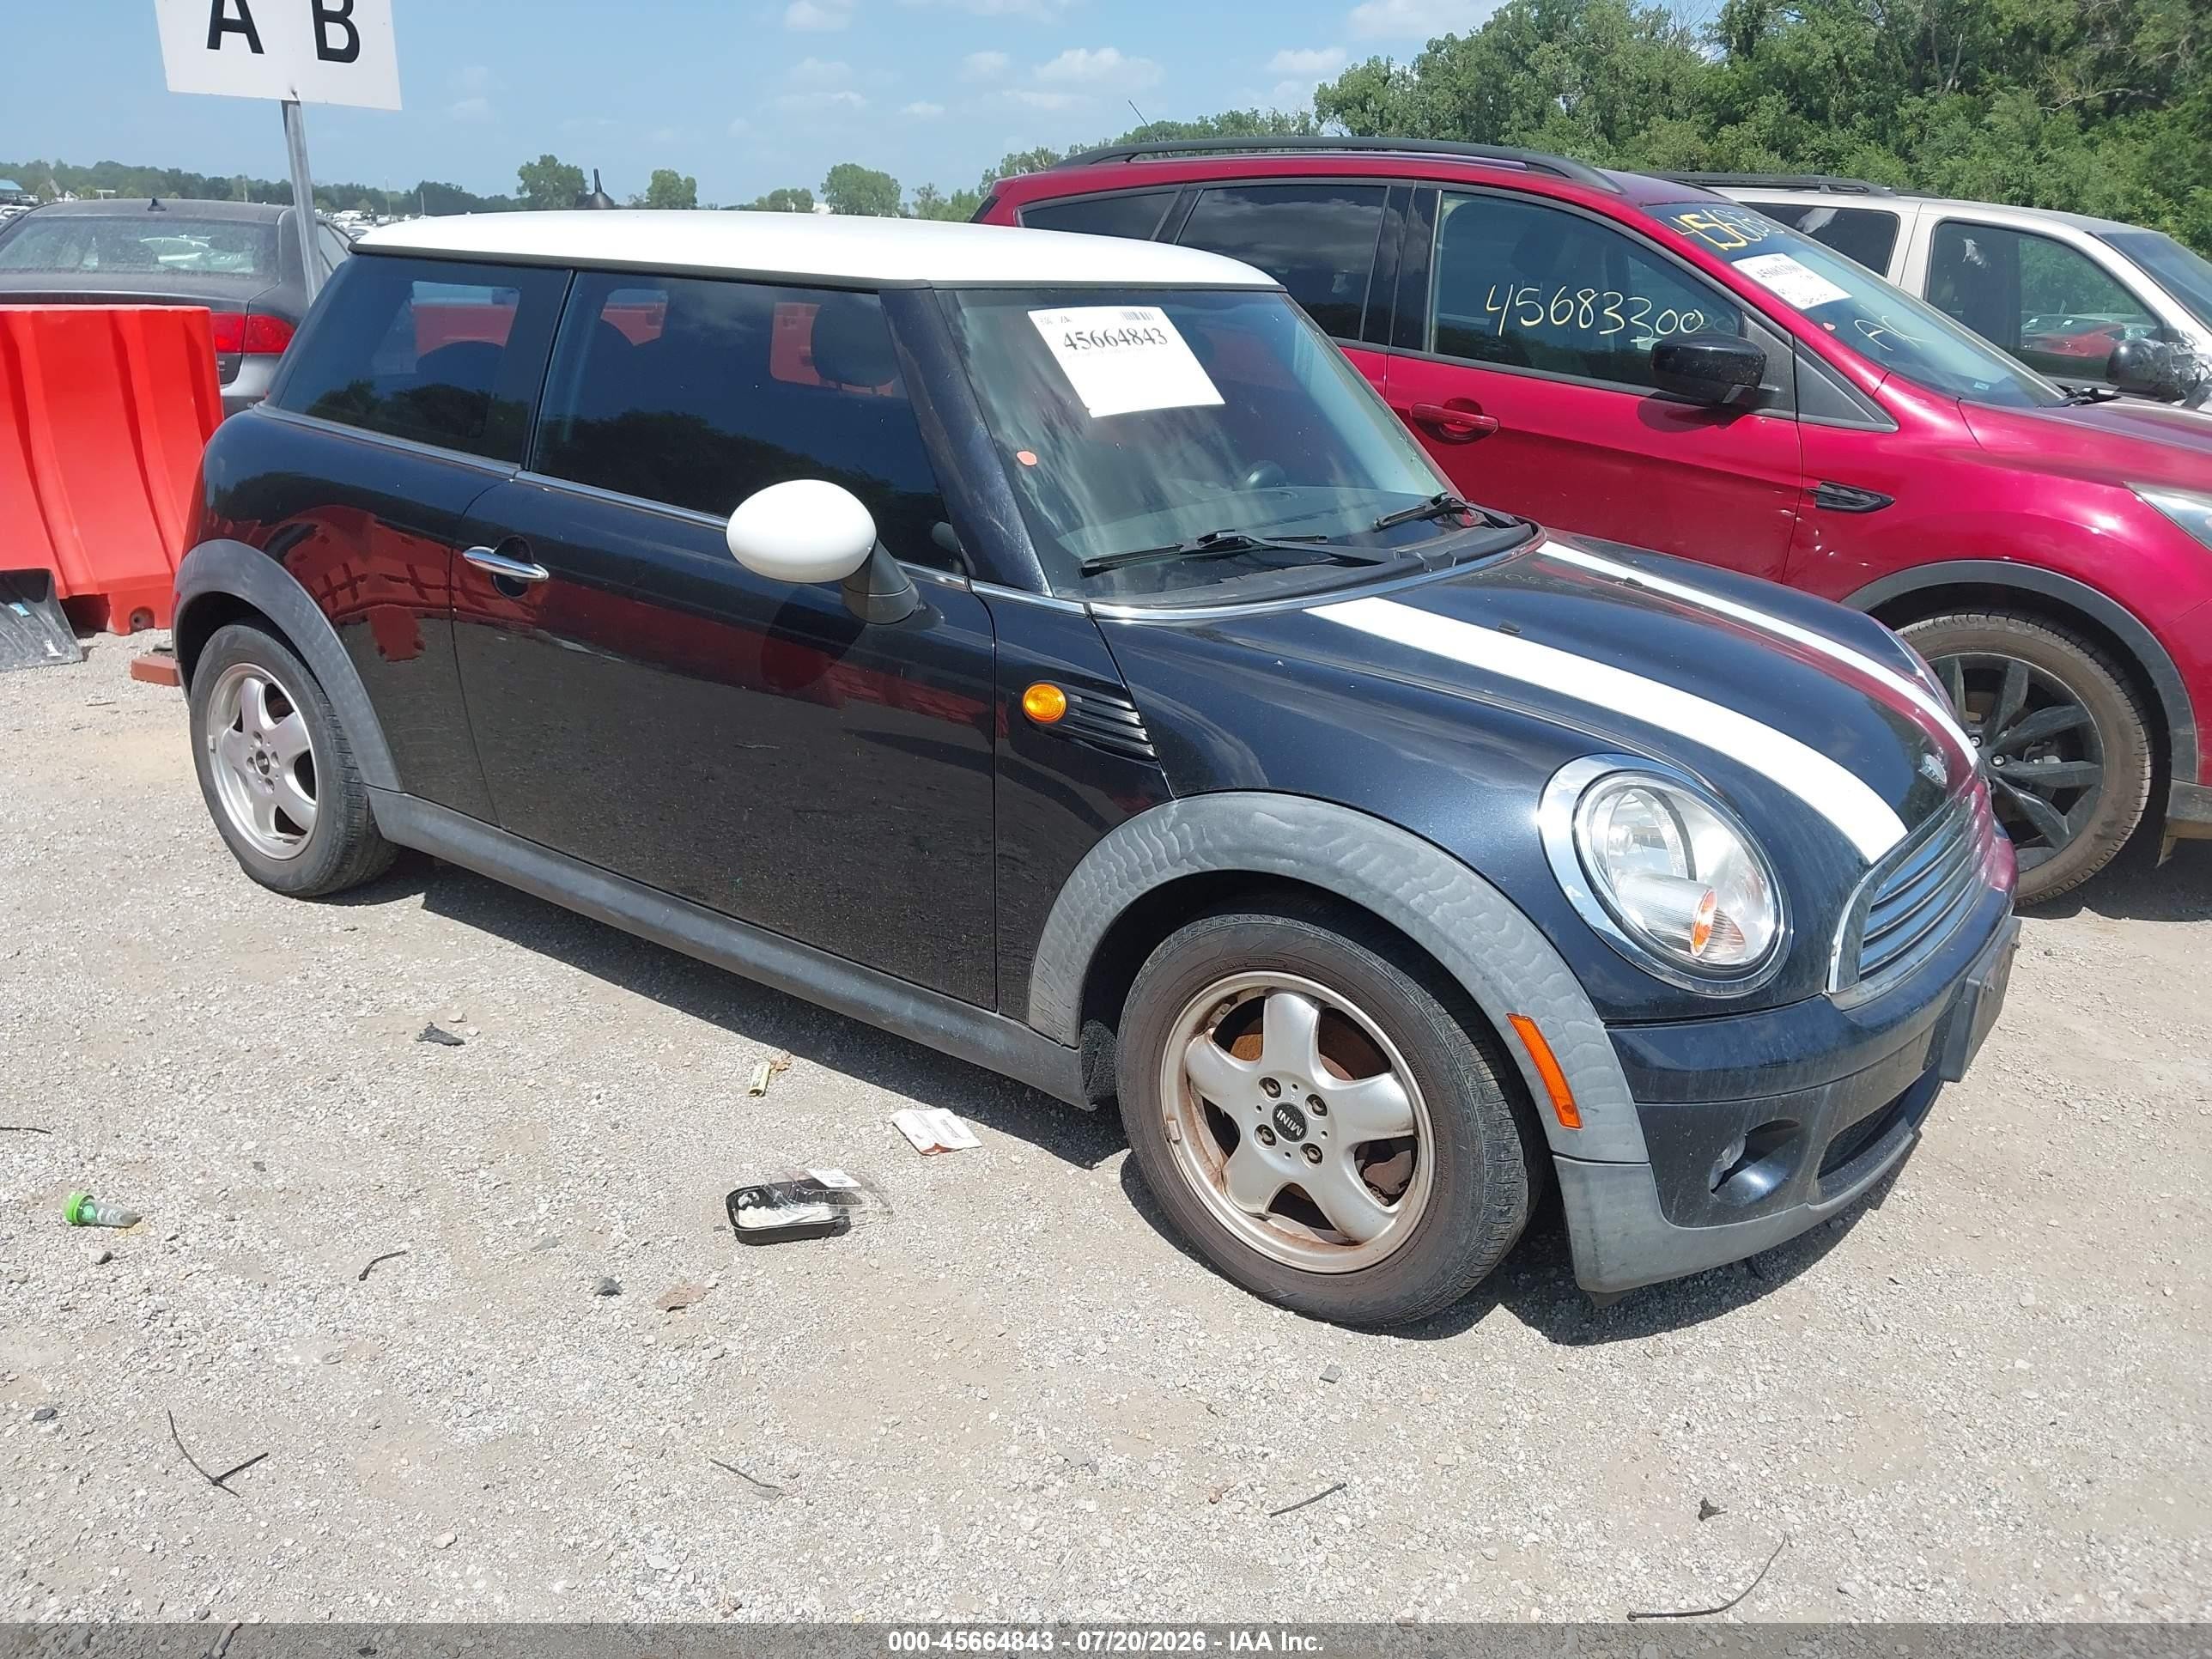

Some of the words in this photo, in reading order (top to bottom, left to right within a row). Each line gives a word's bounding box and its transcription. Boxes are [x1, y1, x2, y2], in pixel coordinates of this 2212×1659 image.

[207, 0, 264, 54] A
[311, 0, 361, 63] B
[1486, 283, 1705, 343] 45683300
[1063, 327, 1168, 349] 45664843
[1276, 1109, 1304, 1137] MINI
